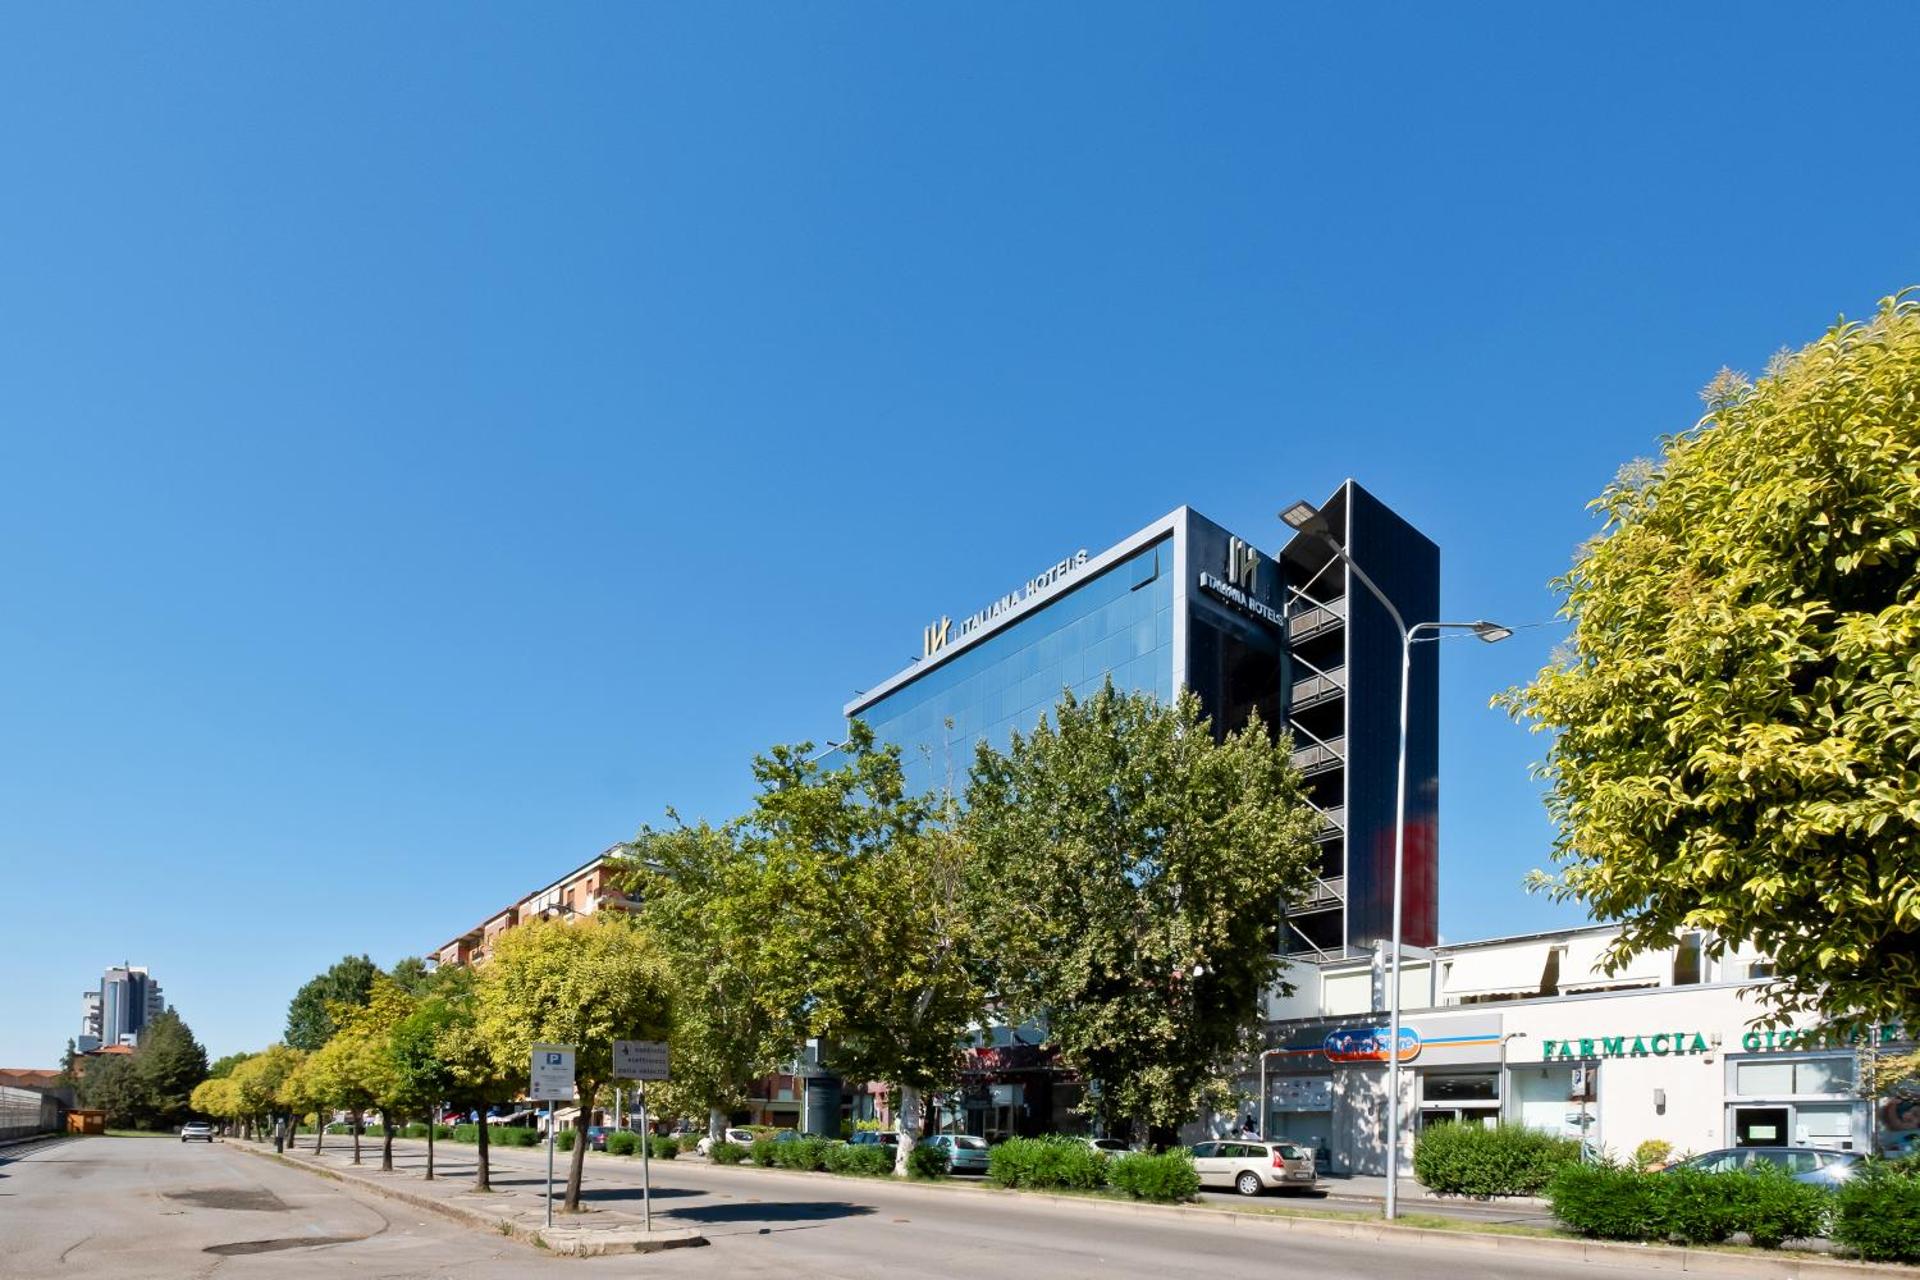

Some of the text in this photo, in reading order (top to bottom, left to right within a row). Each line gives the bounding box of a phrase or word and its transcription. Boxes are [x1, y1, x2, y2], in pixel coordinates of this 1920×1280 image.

[959, 549, 1088, 637] ITALIANA HOTELS
[1248, 597, 1284, 626] HOTELS
[1543, 1032, 1707, 1058] FARMACIA
